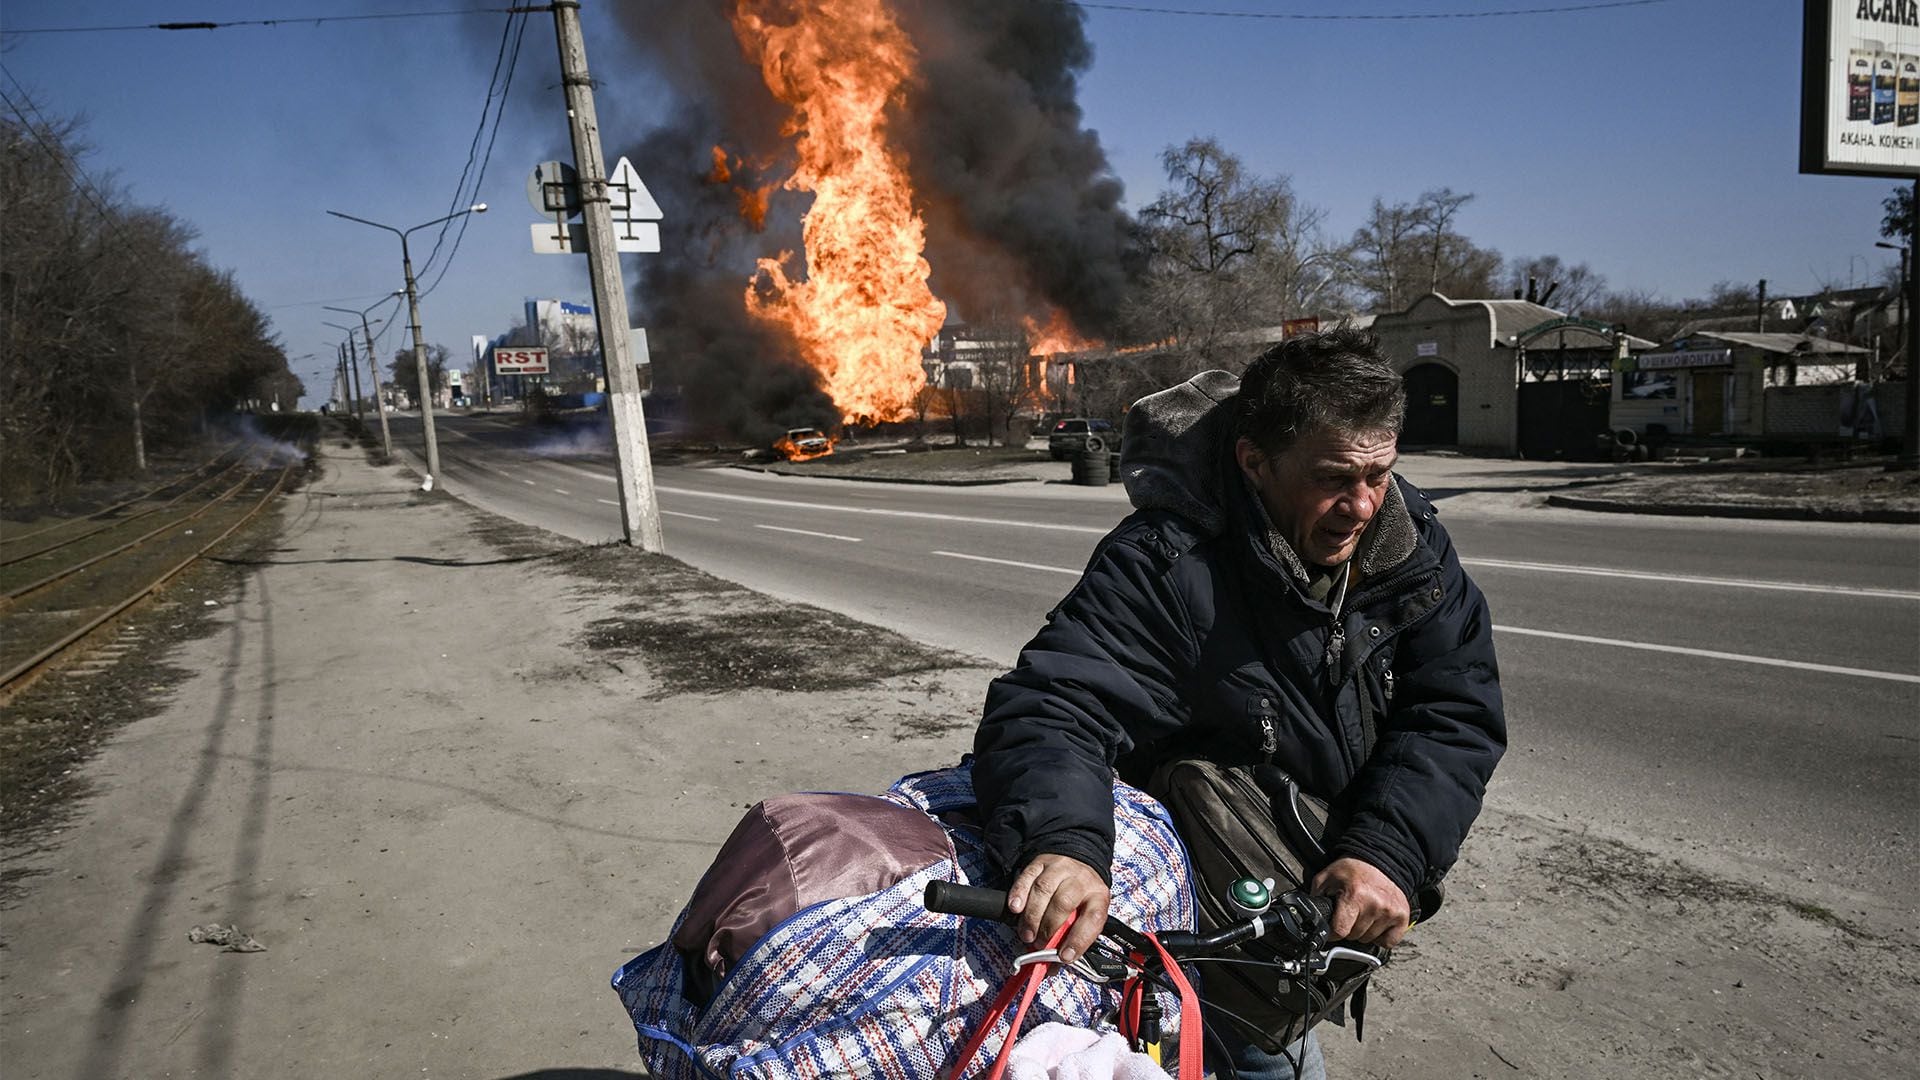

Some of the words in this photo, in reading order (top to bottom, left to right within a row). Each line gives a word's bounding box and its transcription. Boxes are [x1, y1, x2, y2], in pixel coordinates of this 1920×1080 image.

[1856, 0, 1919, 28] ACANA
[1879, 135, 1914, 149] КОЖЕН
[497, 352, 546, 364] RST
